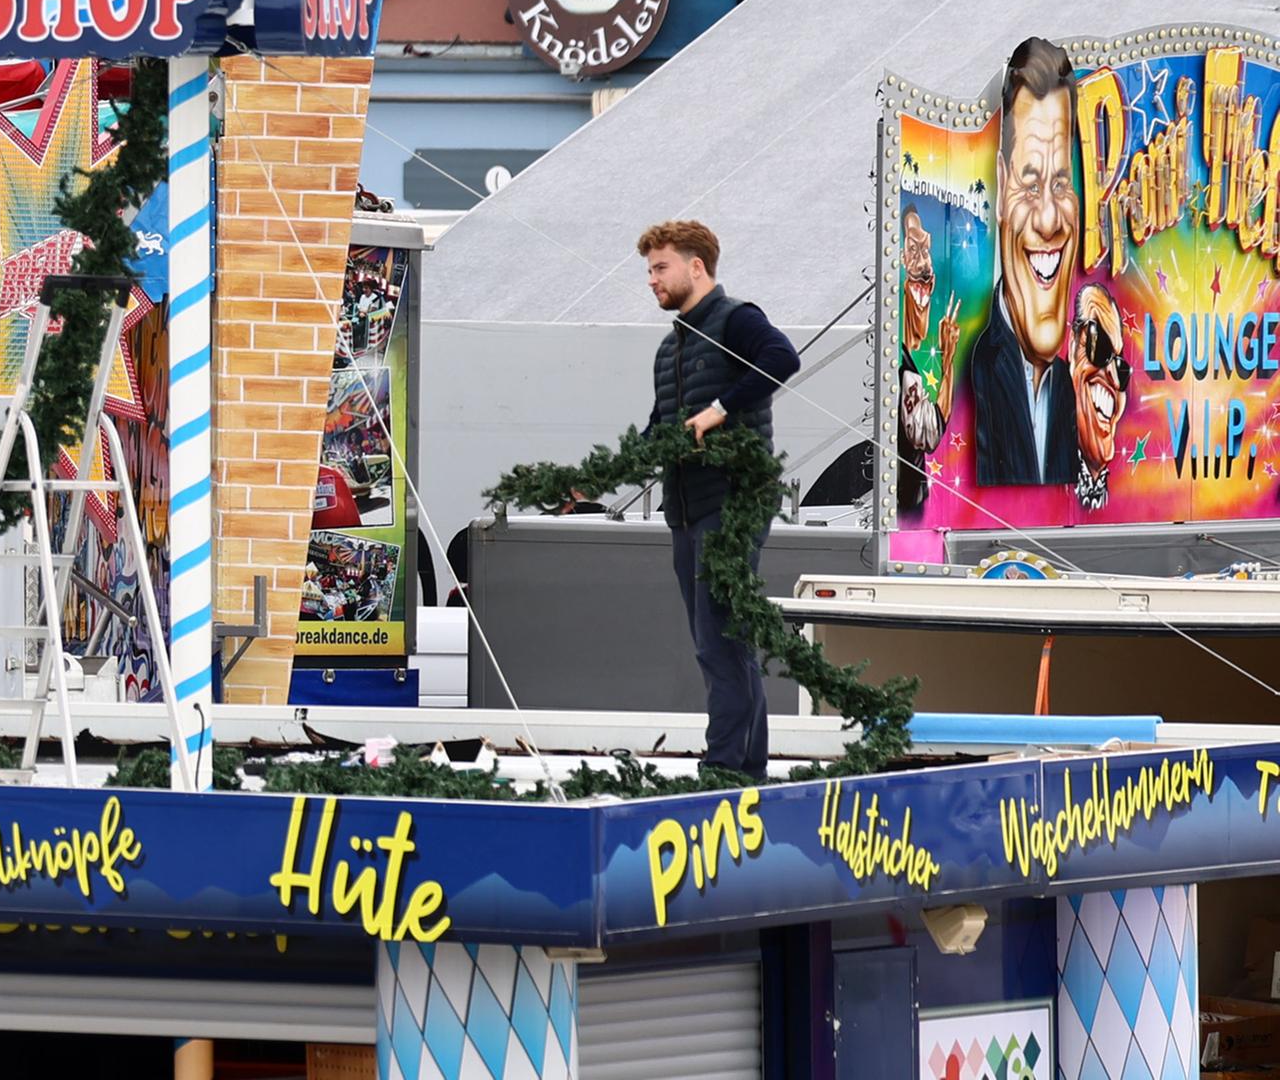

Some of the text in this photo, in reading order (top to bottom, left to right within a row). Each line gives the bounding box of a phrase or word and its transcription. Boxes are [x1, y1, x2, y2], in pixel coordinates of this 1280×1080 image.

[913, 179, 966, 208] HOLLYWOOD
[1075, 64, 1194, 280] Promi
[1142, 311, 1280, 382] LOUNGE
[1166, 396, 1258, 468] V.I.P.
[269, 796, 453, 943] Hüte
[647, 788, 765, 927] Pins
[818, 780, 940, 890] Halstücher
[999, 747, 1216, 879] Wäscheklammern
